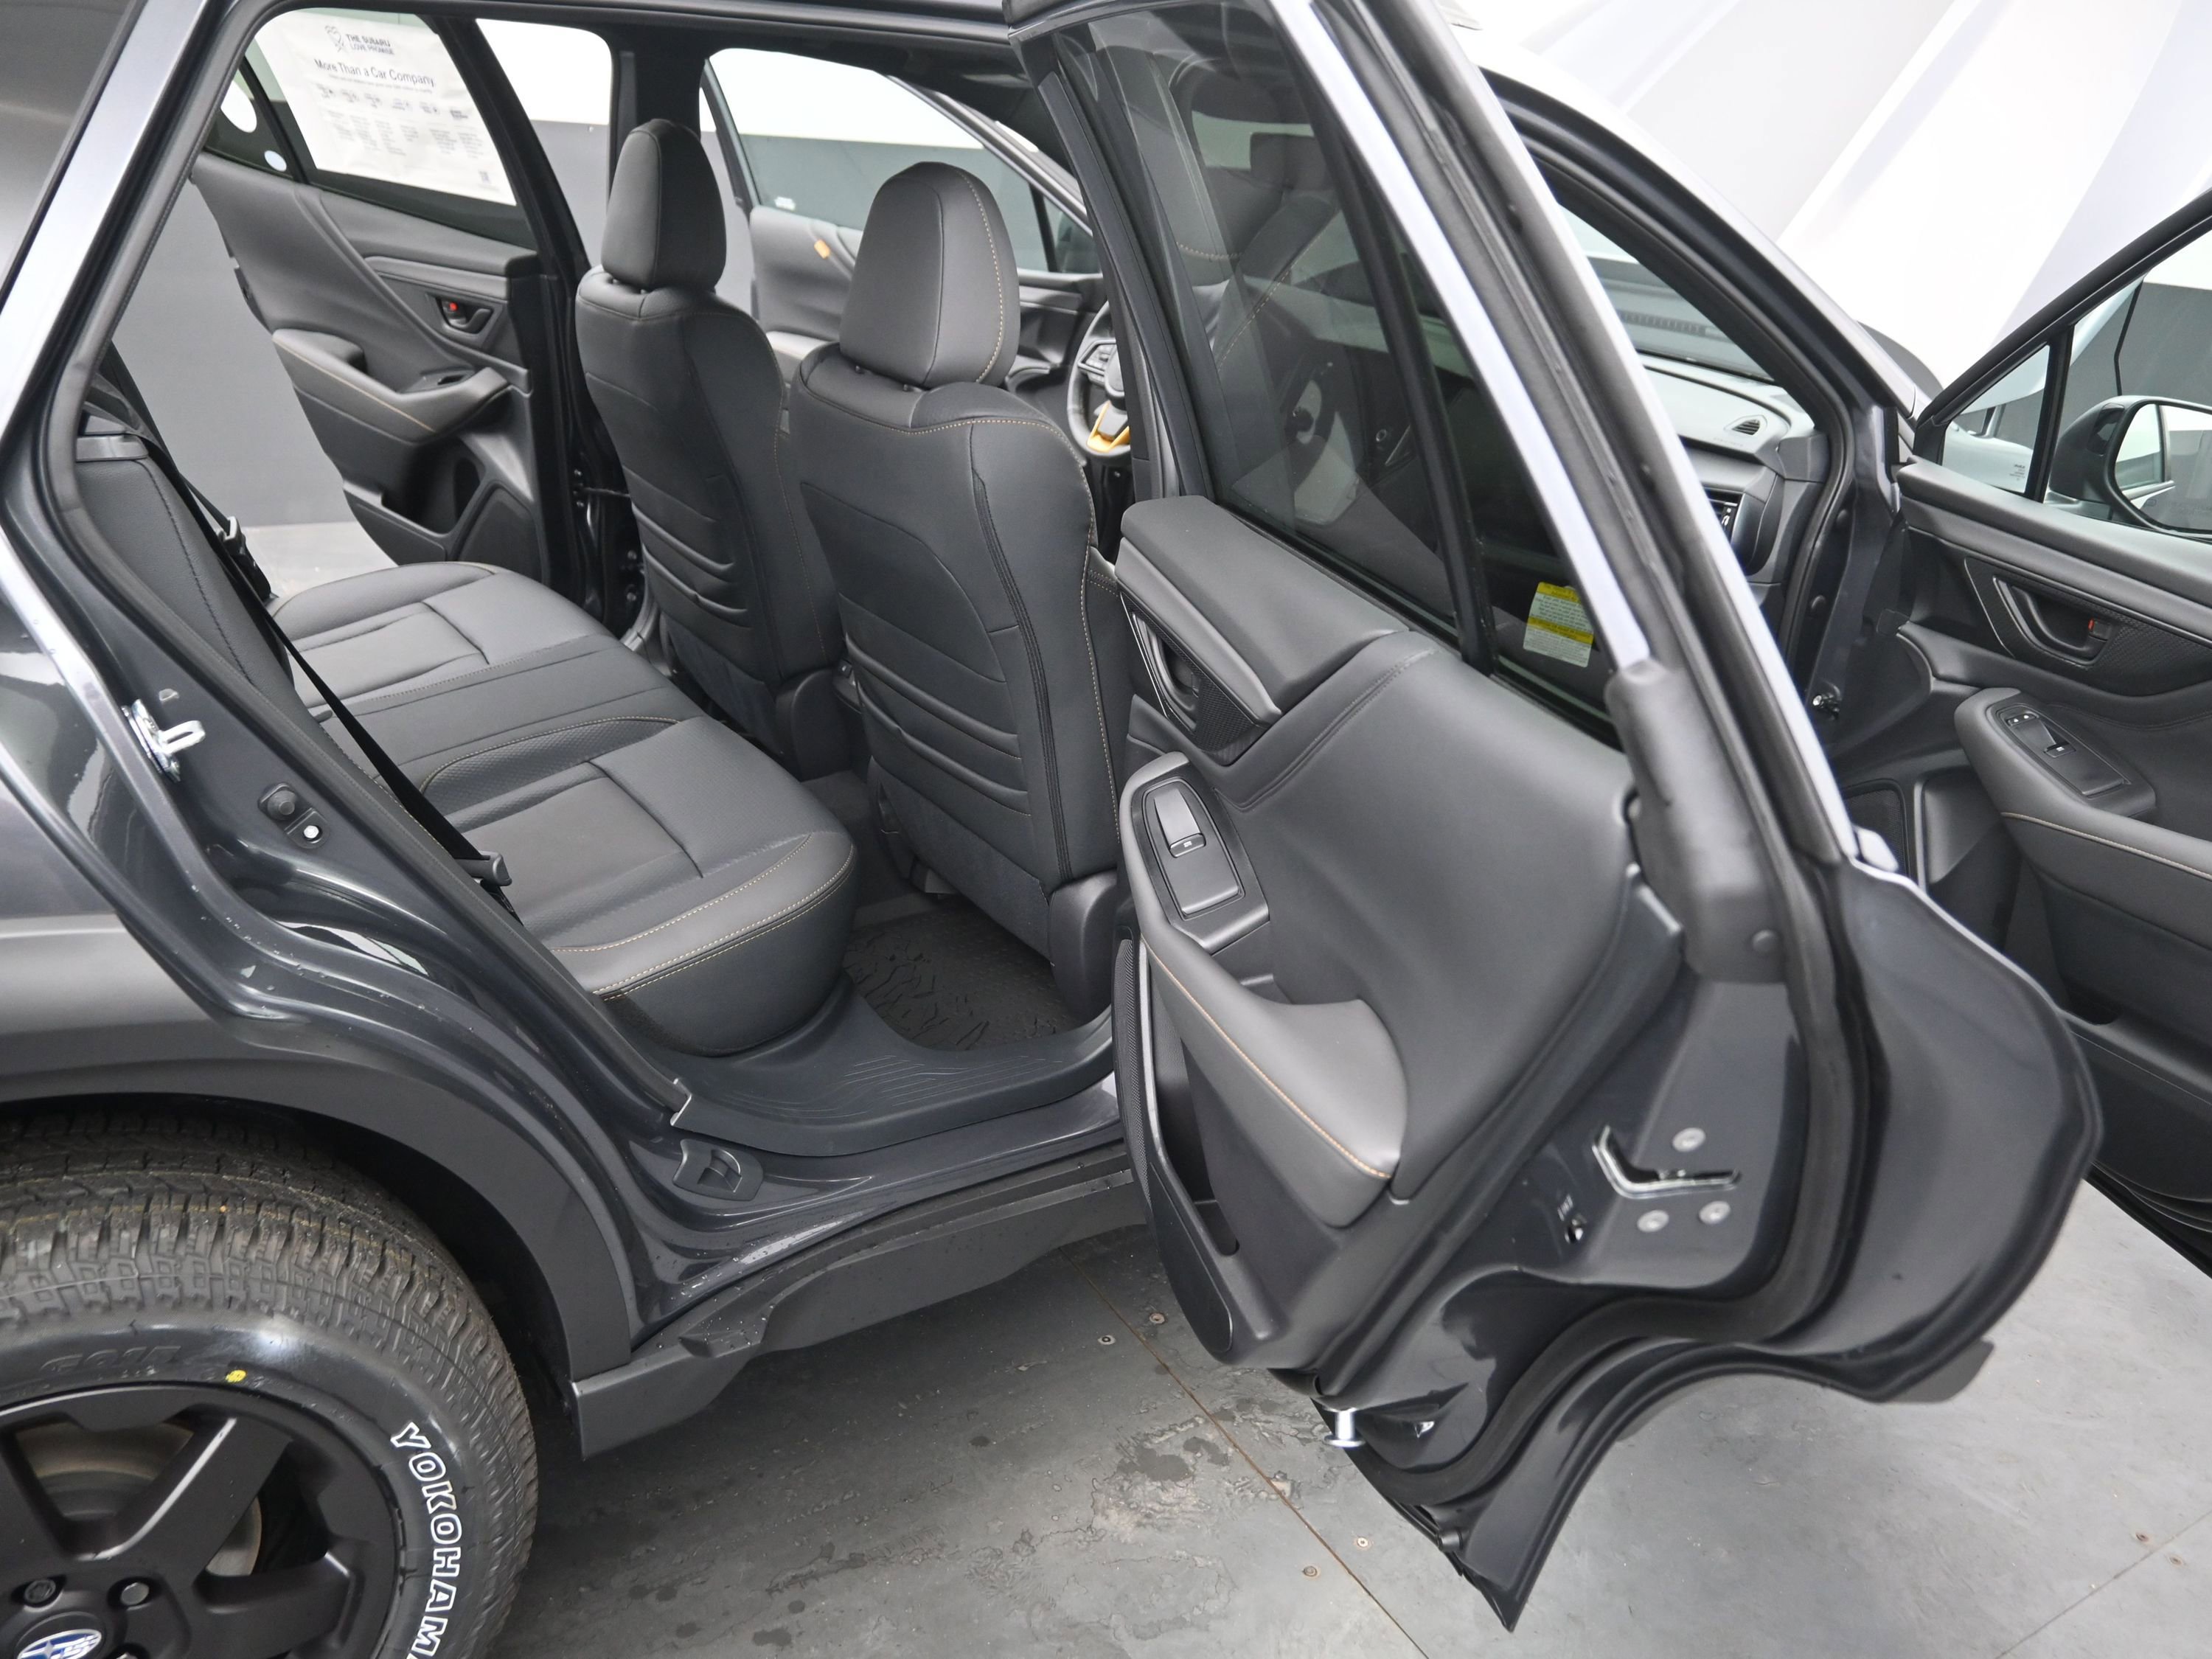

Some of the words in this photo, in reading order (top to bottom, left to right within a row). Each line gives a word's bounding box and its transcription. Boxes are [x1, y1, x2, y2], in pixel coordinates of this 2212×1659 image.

[345, 33, 361, 43] THE
[362, 35, 391, 47] SUBARU
[349, 43, 367, 52] LOVE
[314, 58, 338, 72] More
[338, 62, 361, 75] Than
[364, 67, 369, 77] a
[370, 66, 387, 80] Car
[389, 69, 434, 87] Company
[390, 1421, 463, 1659] YOKOHAM
